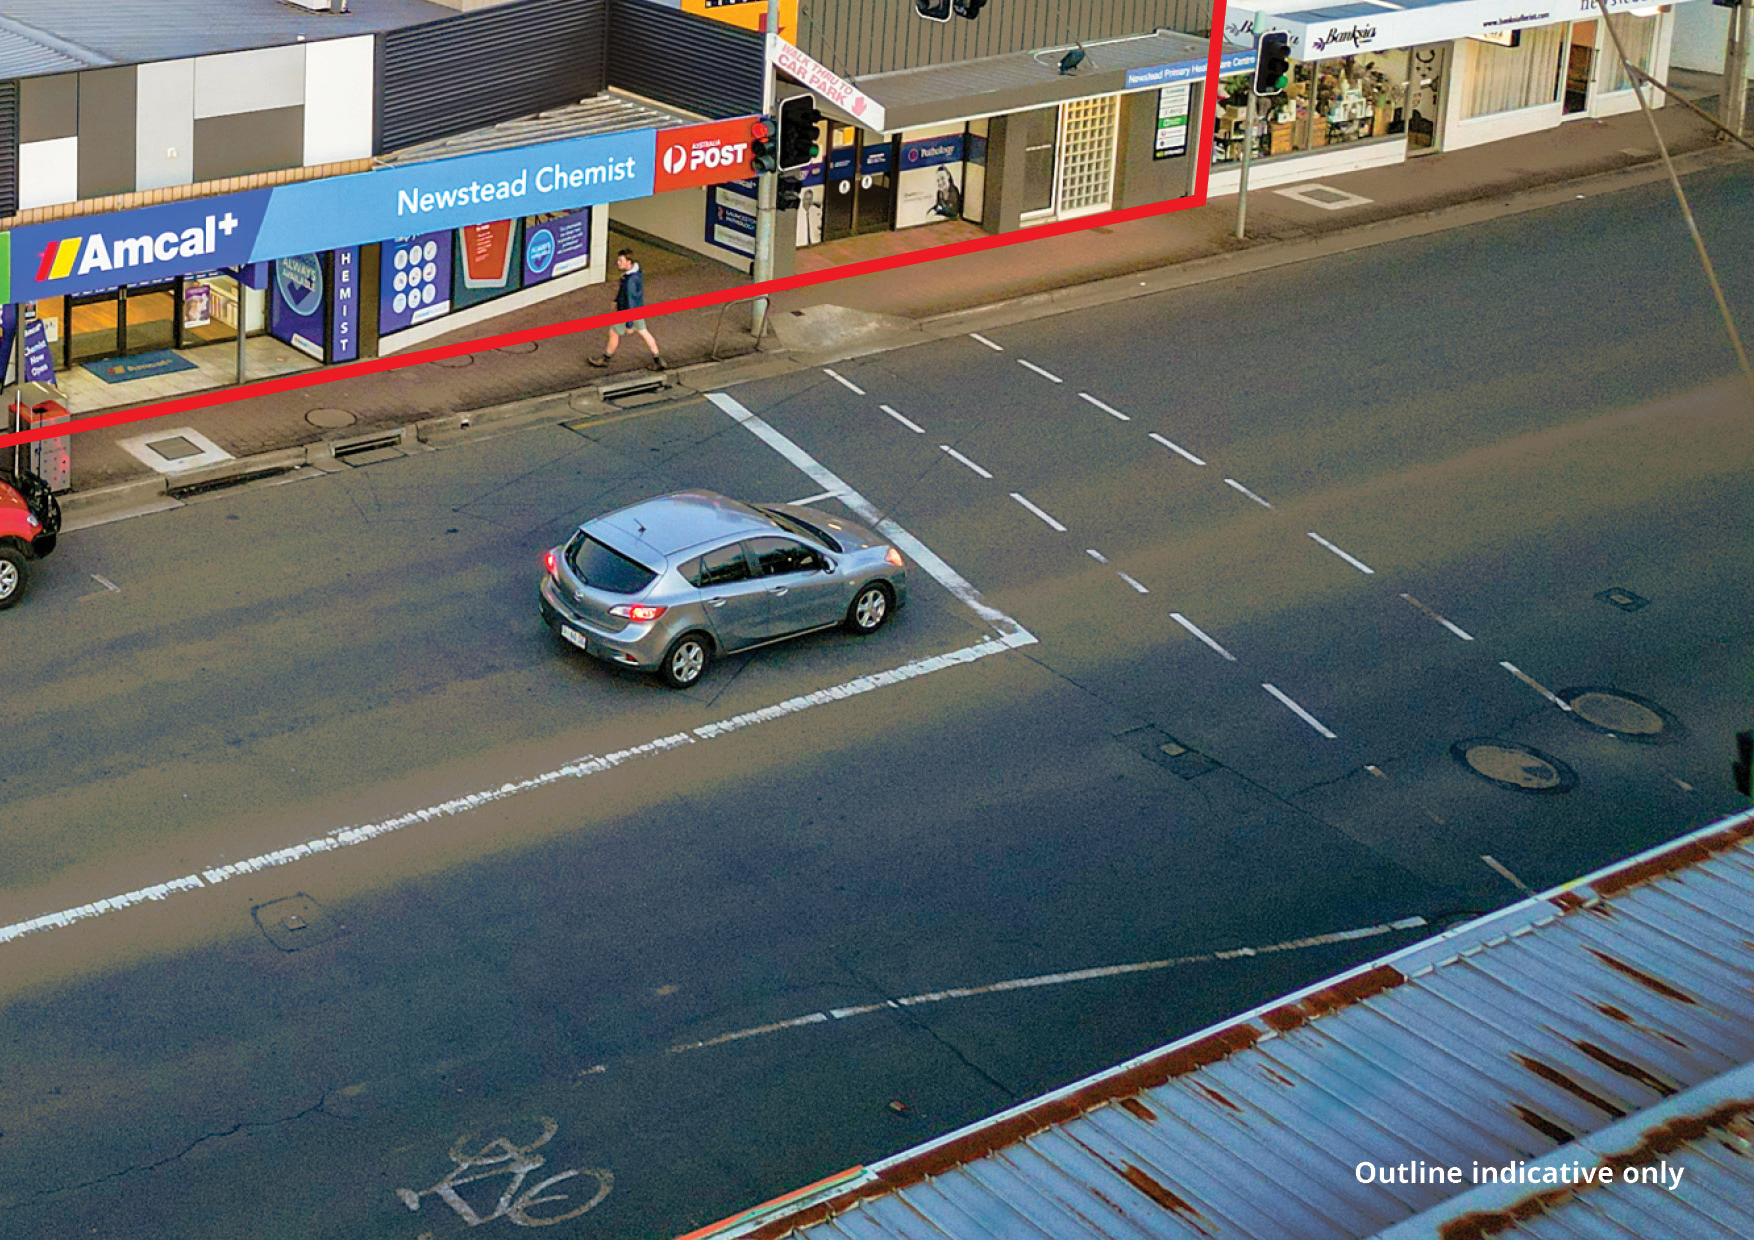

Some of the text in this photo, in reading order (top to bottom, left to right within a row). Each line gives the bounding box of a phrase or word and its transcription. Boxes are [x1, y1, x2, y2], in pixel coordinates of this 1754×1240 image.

[1326, 23, 1377, 48] Banksia
[778, 54, 847, 106] CAR PARK
[782, 43, 853, 95] WALK THRU TO
[1128, 69, 1163, 84] Newstead
[1164, 66, 1190, 79] Primary
[1233, 56, 1256, 67] Centre
[690, 143, 748, 171] POST
[692, 139, 721, 149] AUSTRALIA
[921, 145, 955, 158] Pathology
[397, 156, 636, 216] Newstead Chemist
[283, 257, 316, 281] ALWAYS
[339, 252, 351, 351] HEMIST
[30, 353, 45, 365] Now
[31, 364, 49, 376] Open
